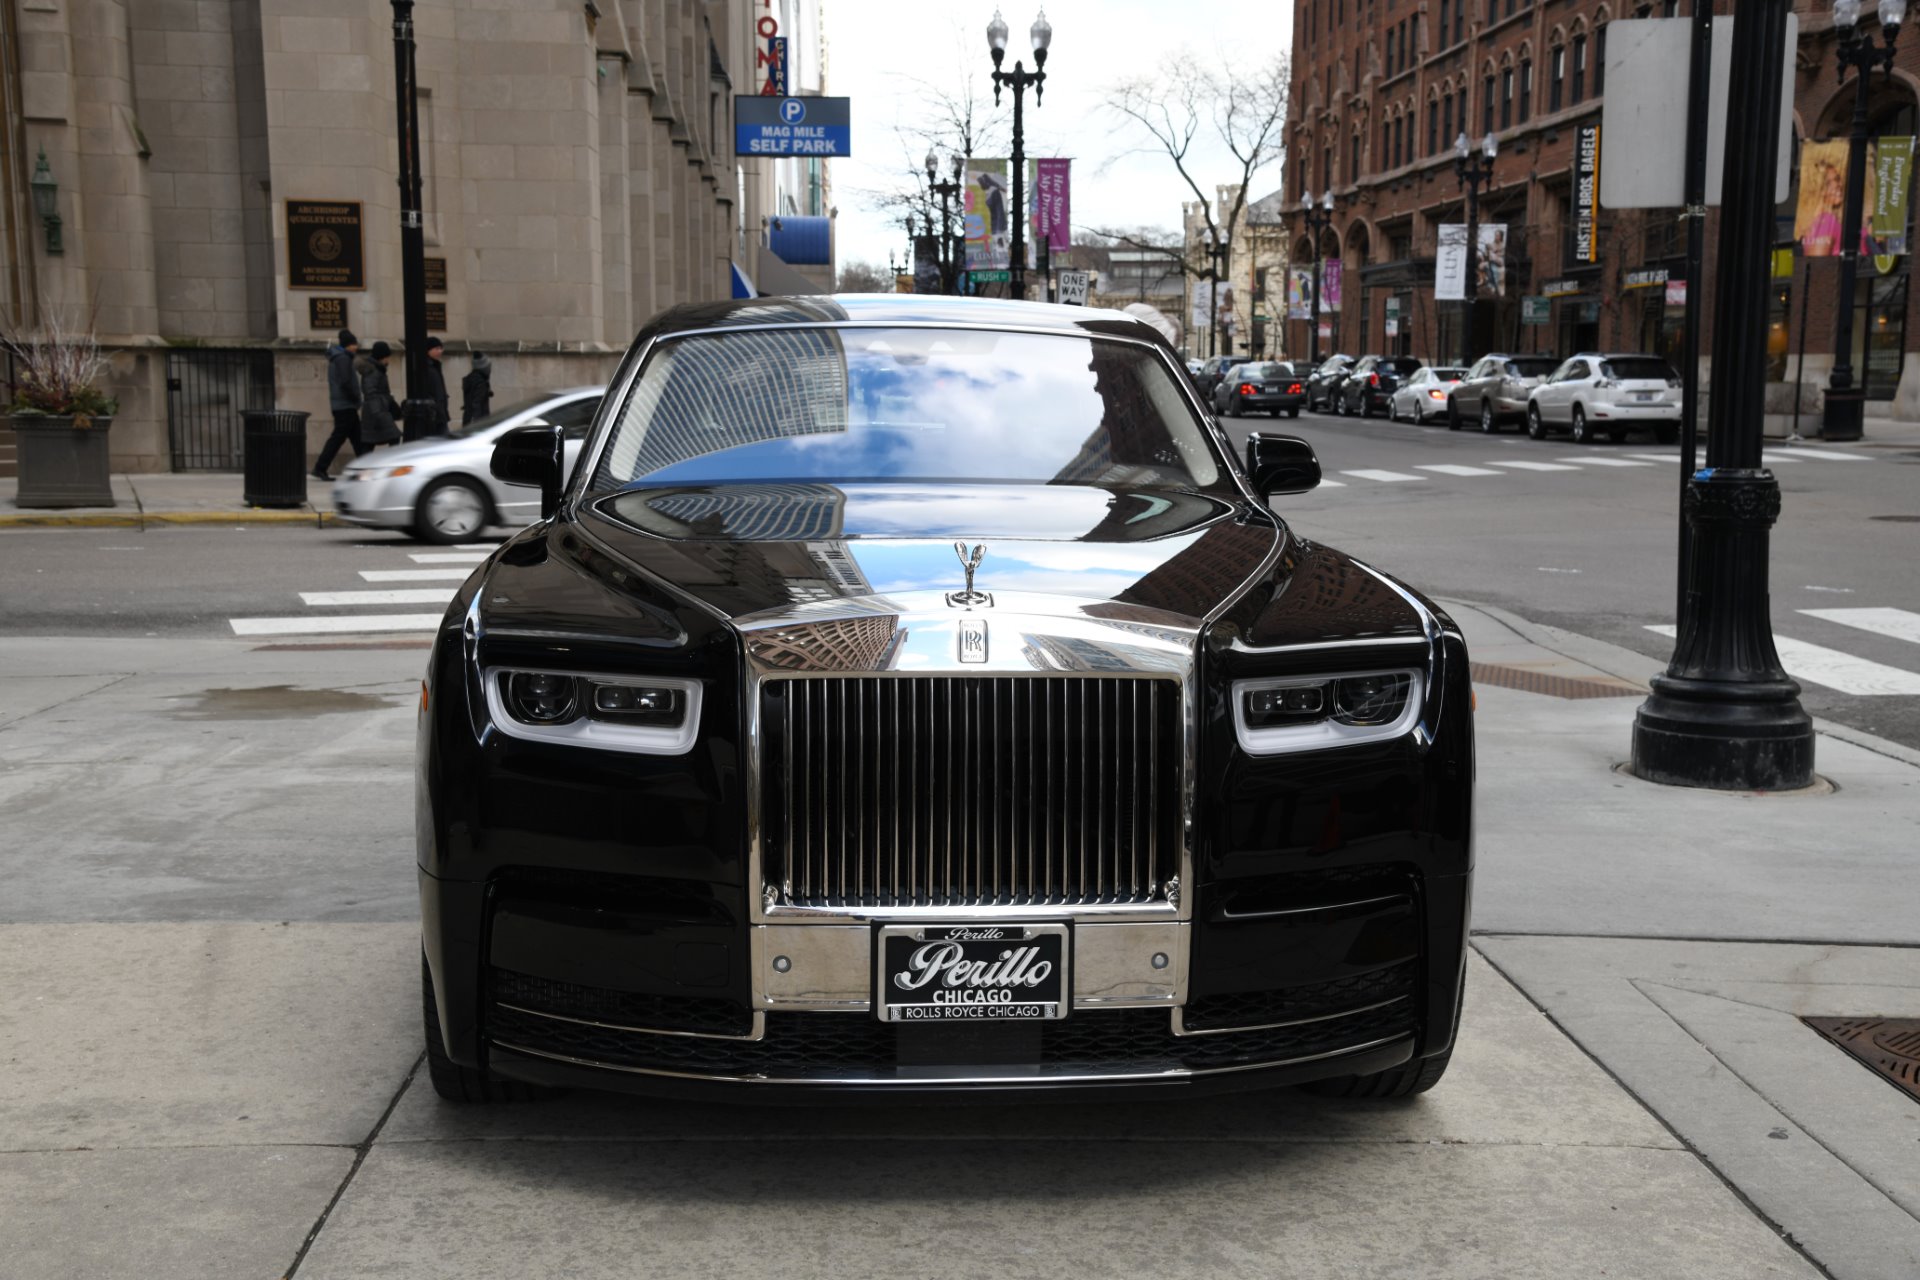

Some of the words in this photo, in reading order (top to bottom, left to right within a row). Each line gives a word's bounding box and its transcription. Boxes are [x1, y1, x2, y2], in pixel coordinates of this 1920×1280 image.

[786, 102, 801, 120] P
[761, 126, 791, 138] MAG
[793, 126, 825, 138] MILE
[750, 139, 790, 152] SELF
[793, 139, 837, 153] PARK
[1580, 128, 1596, 172] BAGELS
[1040, 173, 1051, 191] My
[1054, 173, 1064, 194] Her
[1877, 156, 1892, 216] Englewood
[1888, 156, 1905, 207] Everyday
[297, 206, 350, 215] ARCHBISHOP
[1052, 195, 1063, 225] Story,
[289, 215, 325, 224] QUIGLEY
[326, 216, 358, 224] CENTER
[1576, 209, 1592, 260] EINSTEIN
[316, 275, 348, 283] CHICAGO
[977, 273, 1000, 281] RUSH
[1062, 274, 1085, 285] ONE
[1061, 286, 1085, 297] WAY
[316, 300, 340, 313] 835
[944, 927, 1004, 940] Perillo
[894, 941, 1052, 990] Perillo
[932, 989, 1012, 1004] CHICAGO
[906, 1006, 941, 1018] ROLLS
[945, 1006, 984, 1018] ROYCE
[987, 1005, 1040, 1017] CHICAGO
